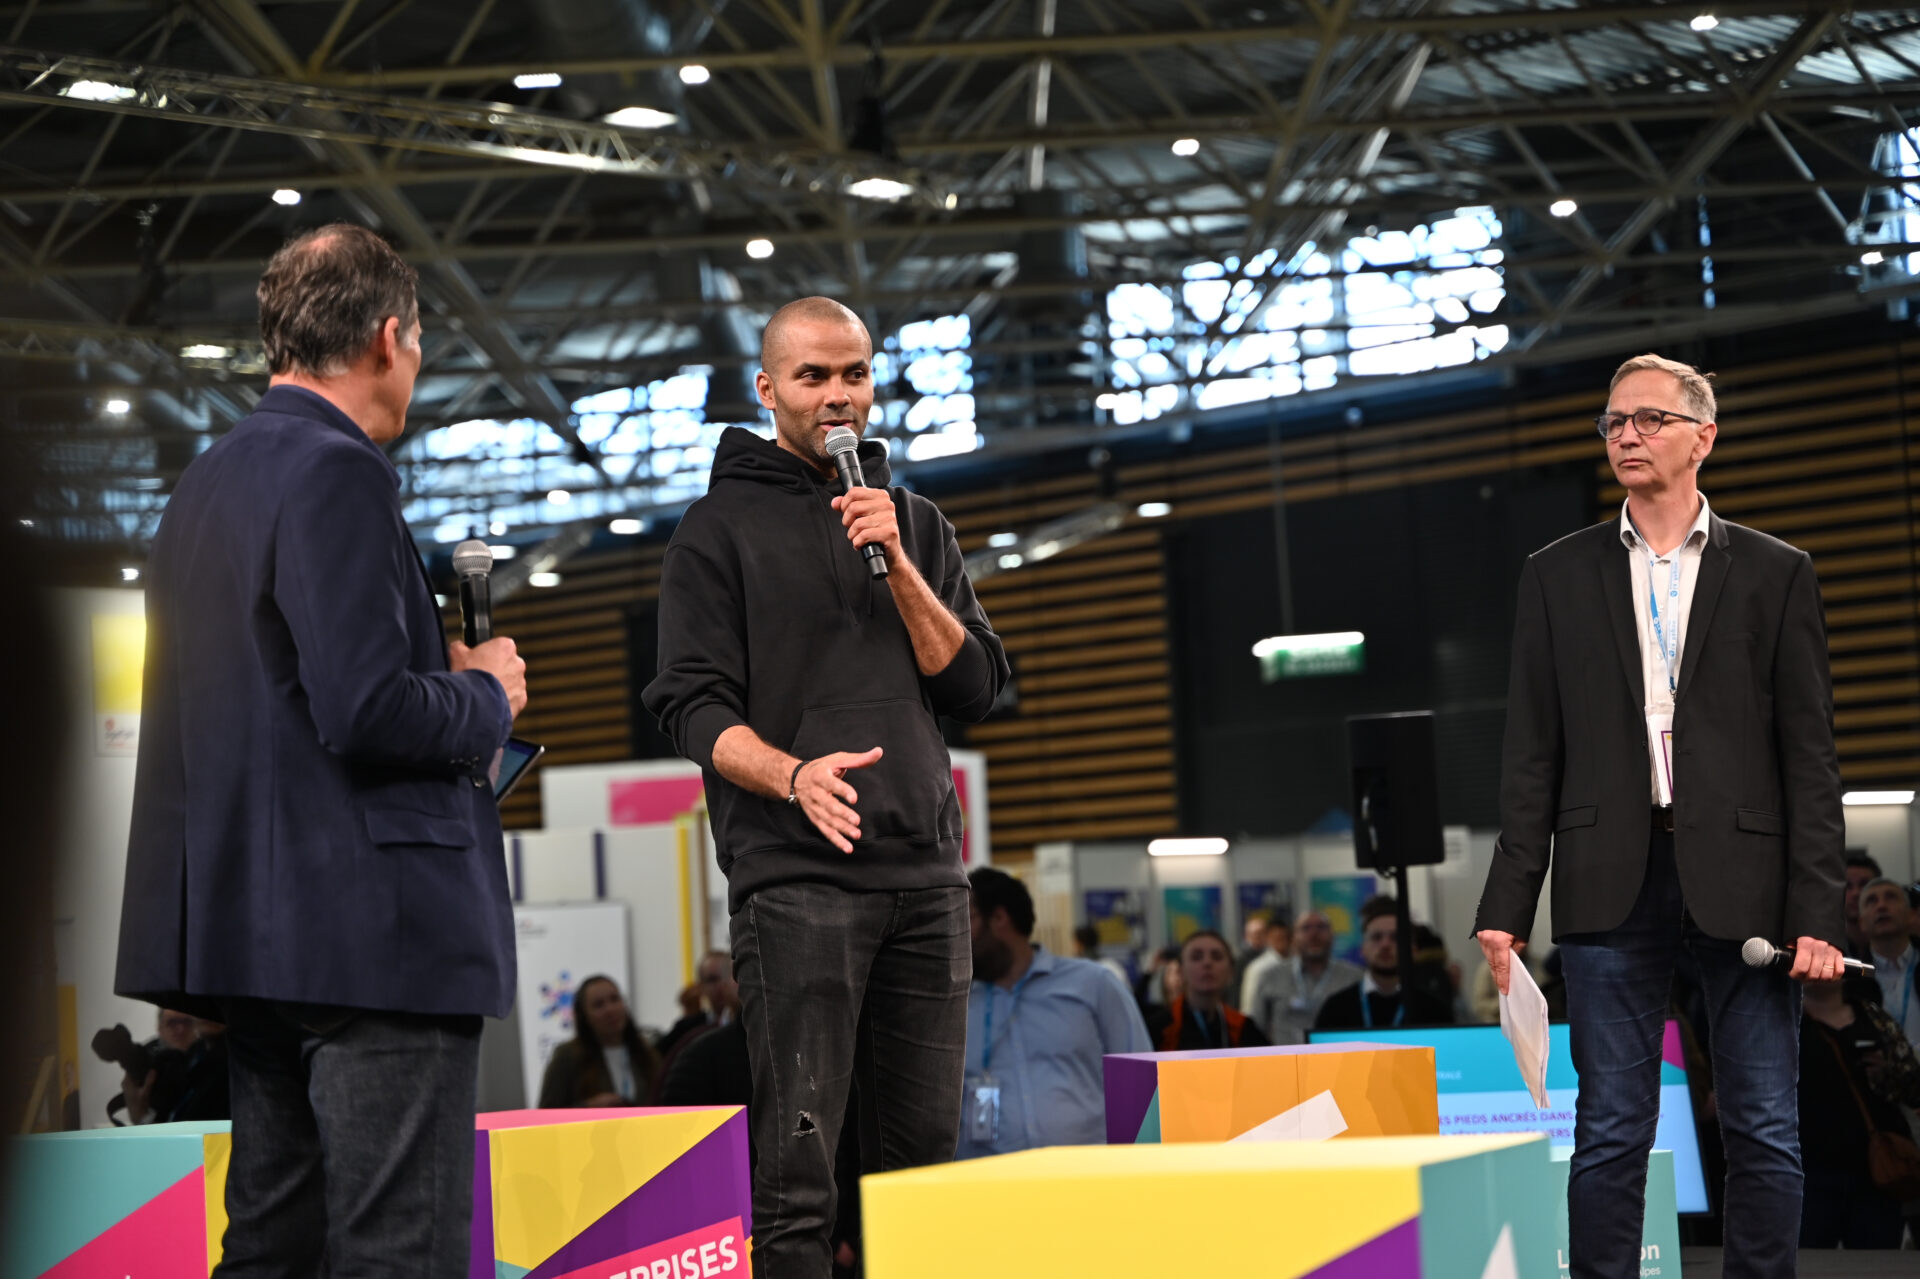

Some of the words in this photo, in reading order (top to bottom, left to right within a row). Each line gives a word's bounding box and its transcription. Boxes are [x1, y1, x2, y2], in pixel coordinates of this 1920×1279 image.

[1454, 1114, 1488, 1125] PIEDS
[1491, 1111, 1537, 1123] ANCRÉS
[1540, 1111, 1573, 1121] DANS
